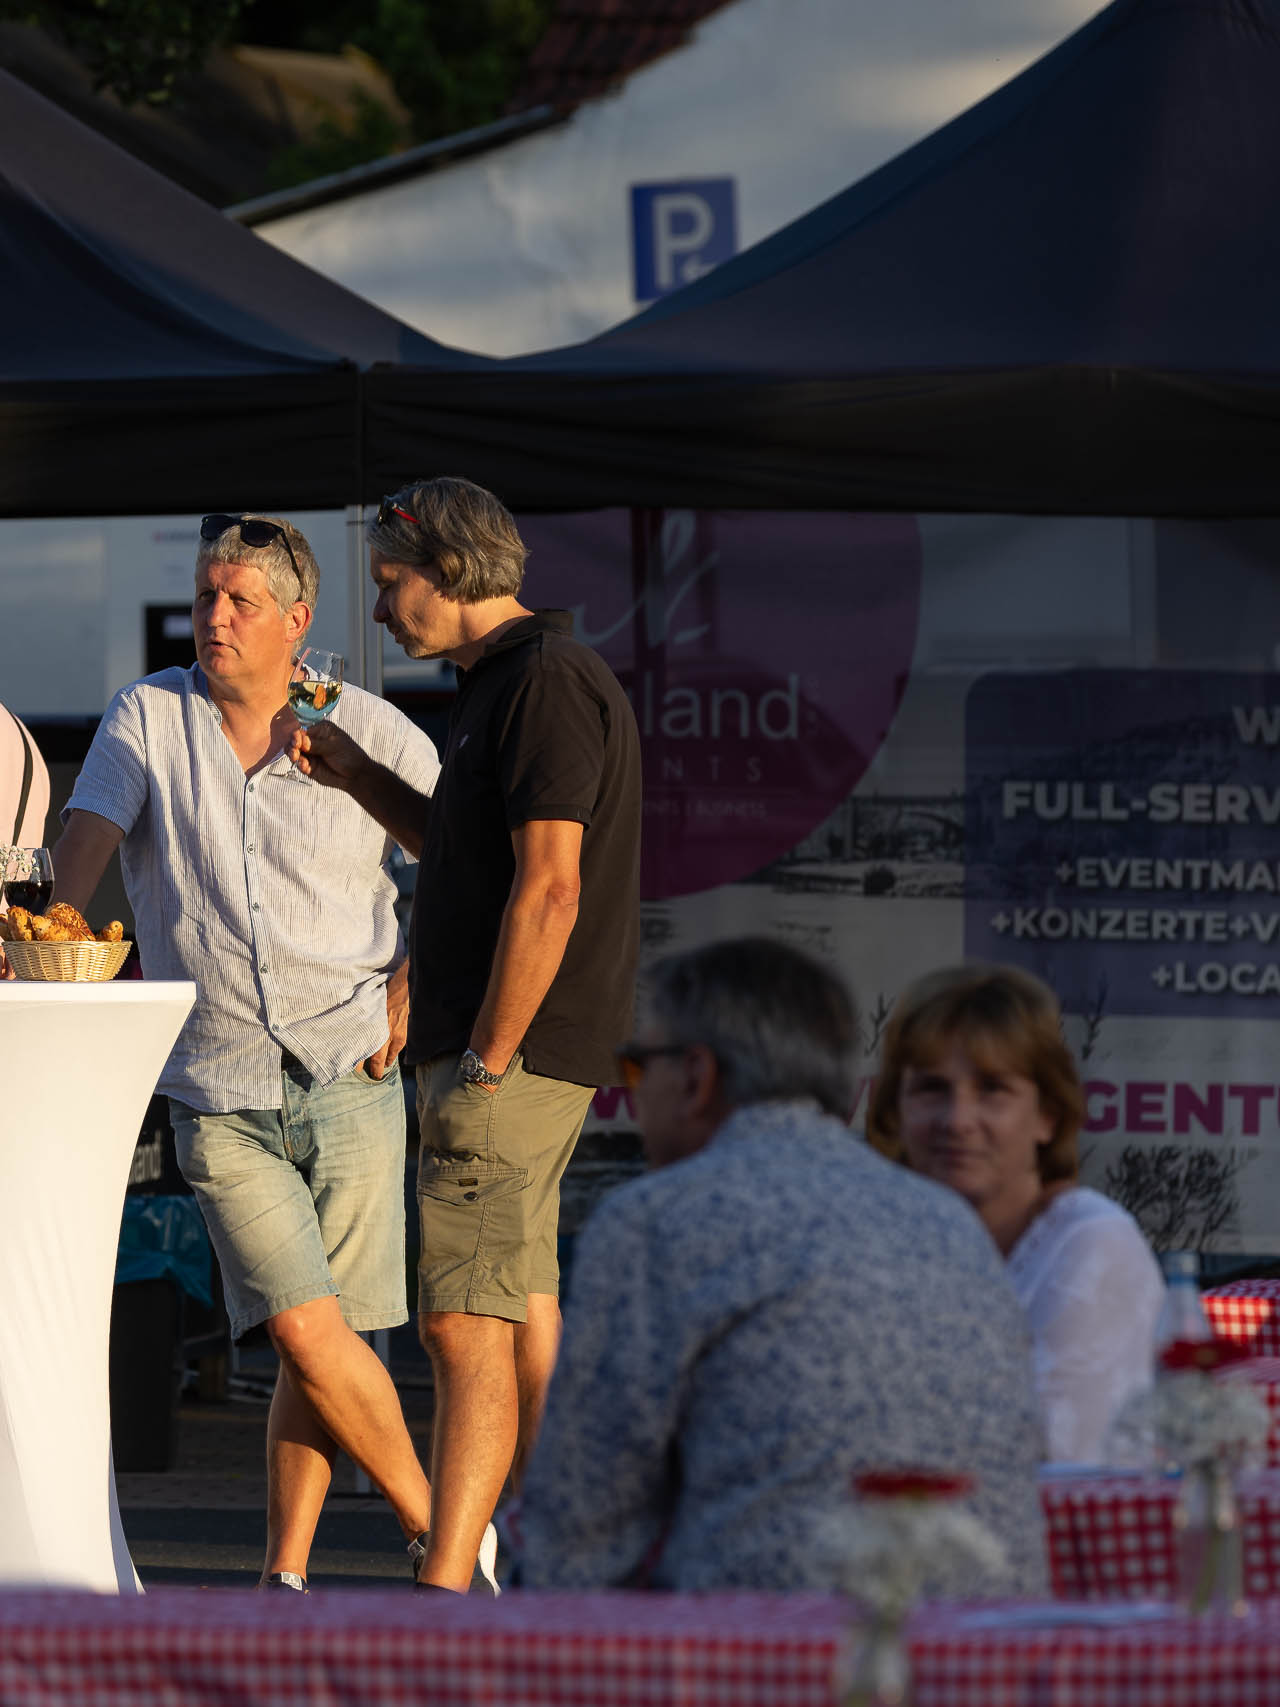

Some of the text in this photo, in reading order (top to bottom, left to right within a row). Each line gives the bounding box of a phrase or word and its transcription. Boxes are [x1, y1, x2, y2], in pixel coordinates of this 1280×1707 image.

[654, 193, 713, 289] P
[625, 671, 800, 740] land
[1056, 857, 1280, 892] +EVENTMA
[1082, 1081, 1280, 1135] GENT
